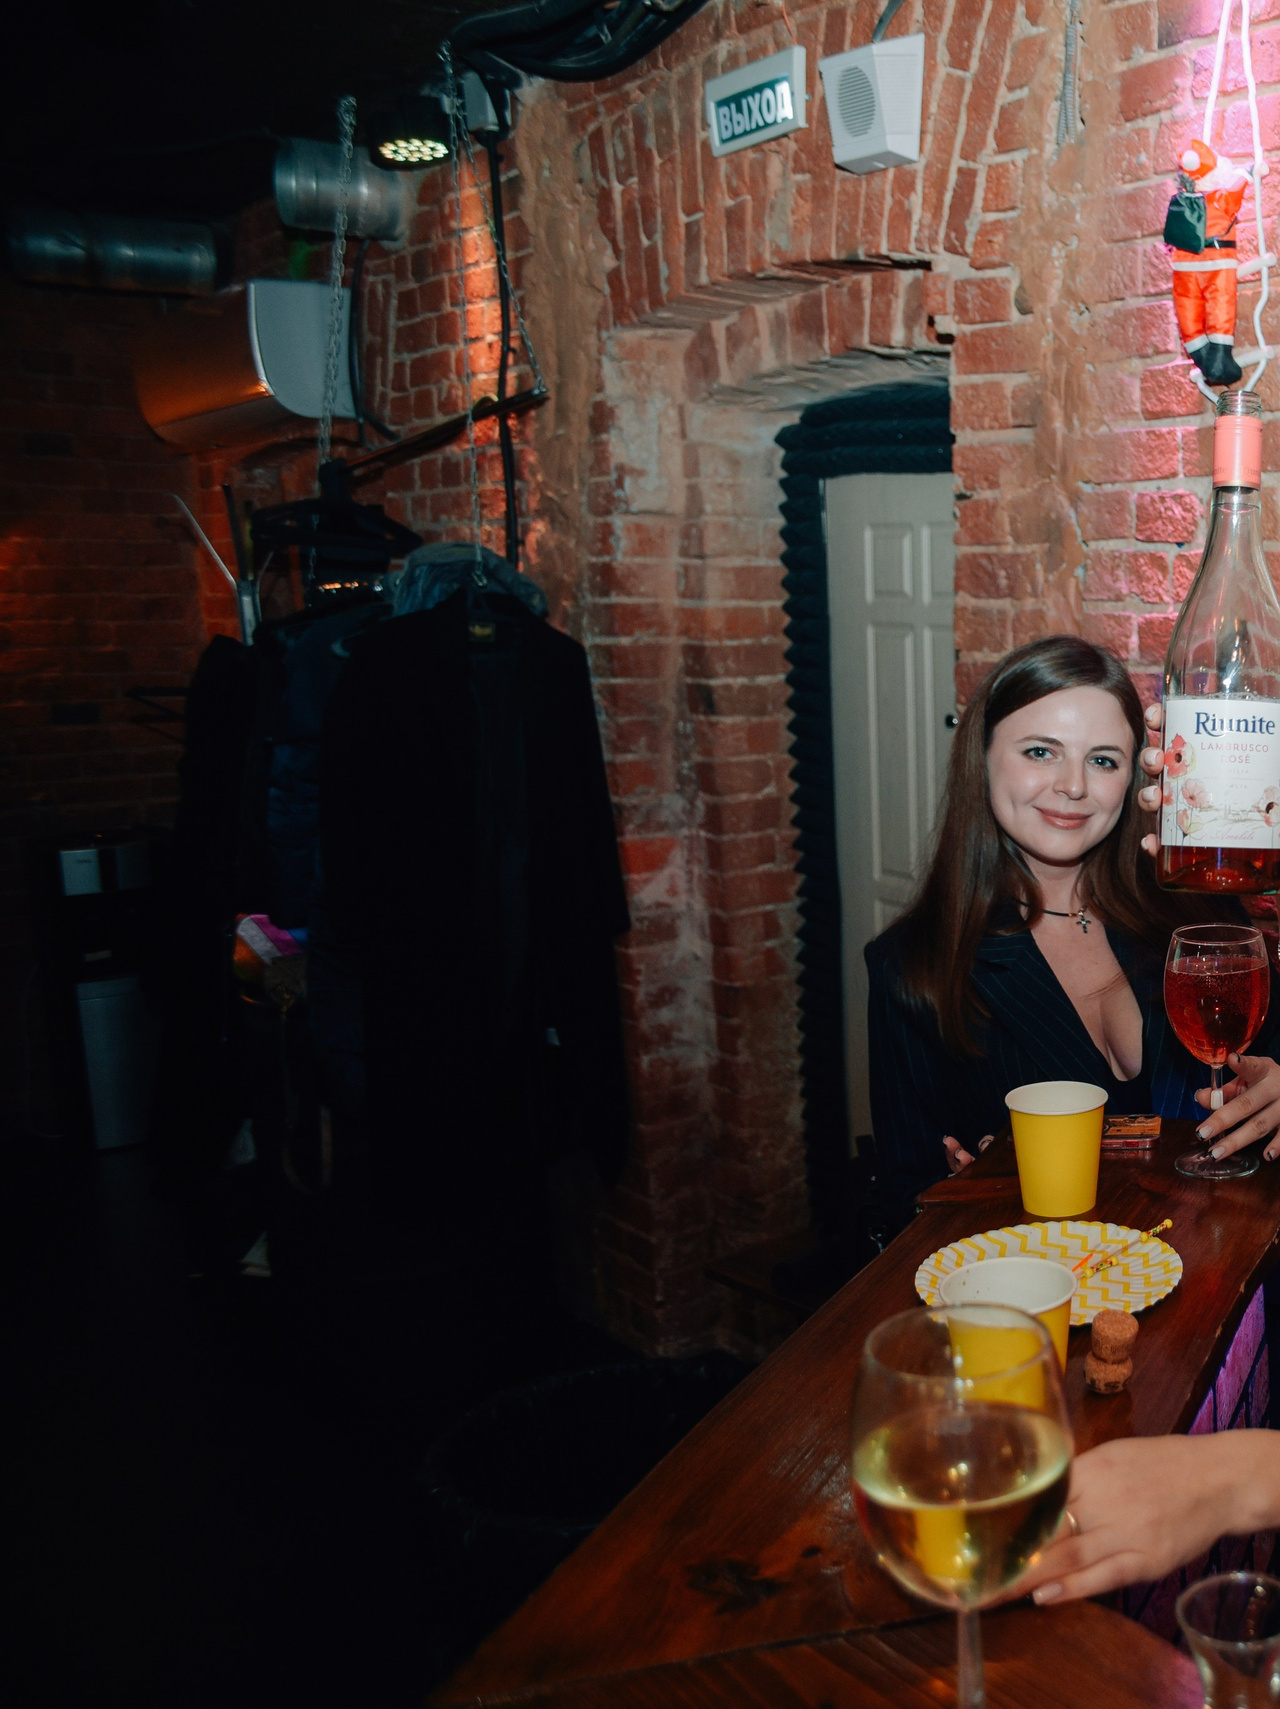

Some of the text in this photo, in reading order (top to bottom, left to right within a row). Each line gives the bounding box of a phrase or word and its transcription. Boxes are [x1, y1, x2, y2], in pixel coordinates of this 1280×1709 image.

[719, 81, 793, 140] ВЫХОД
[1194, 711, 1276, 737] Riunite
[1200, 742, 1269, 753] LAMBRUSCO
